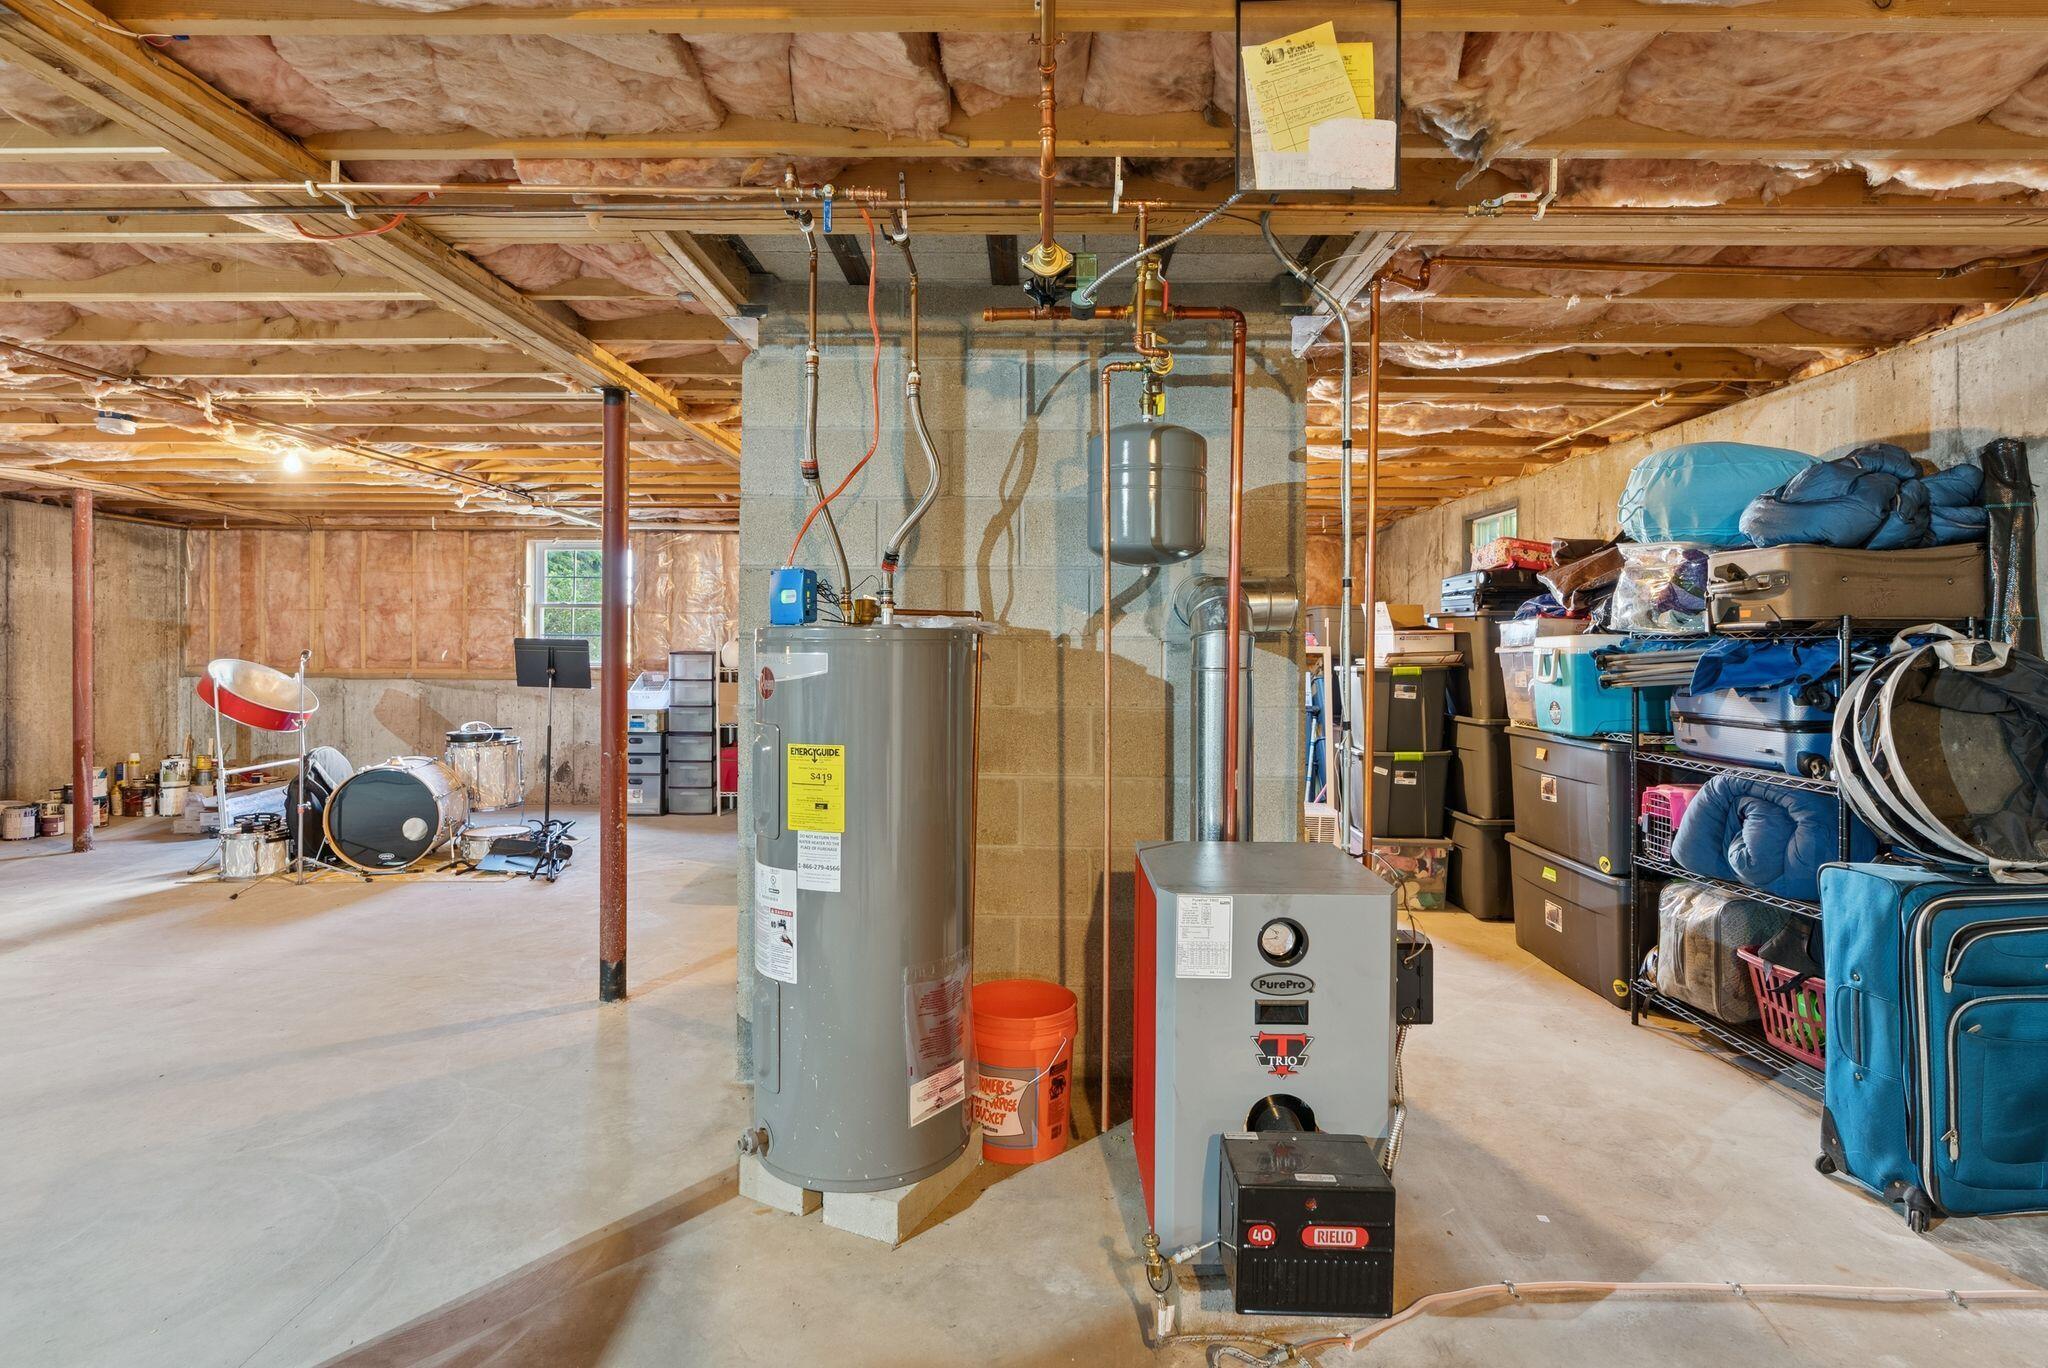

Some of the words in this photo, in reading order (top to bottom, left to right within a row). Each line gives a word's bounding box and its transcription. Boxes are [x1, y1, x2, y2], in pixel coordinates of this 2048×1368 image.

[790, 747, 840, 757] ENERGYGUIDE
[798, 863, 840, 871] 1-866-279-4566
[1259, 979, 1306, 989] PurePro
[1267, 1055, 1298, 1066] TRIO
[975, 1105, 1006, 1125] BUCKET
[1252, 1228, 1272, 1242] 40
[1317, 1230, 1353, 1244] RIELLO
